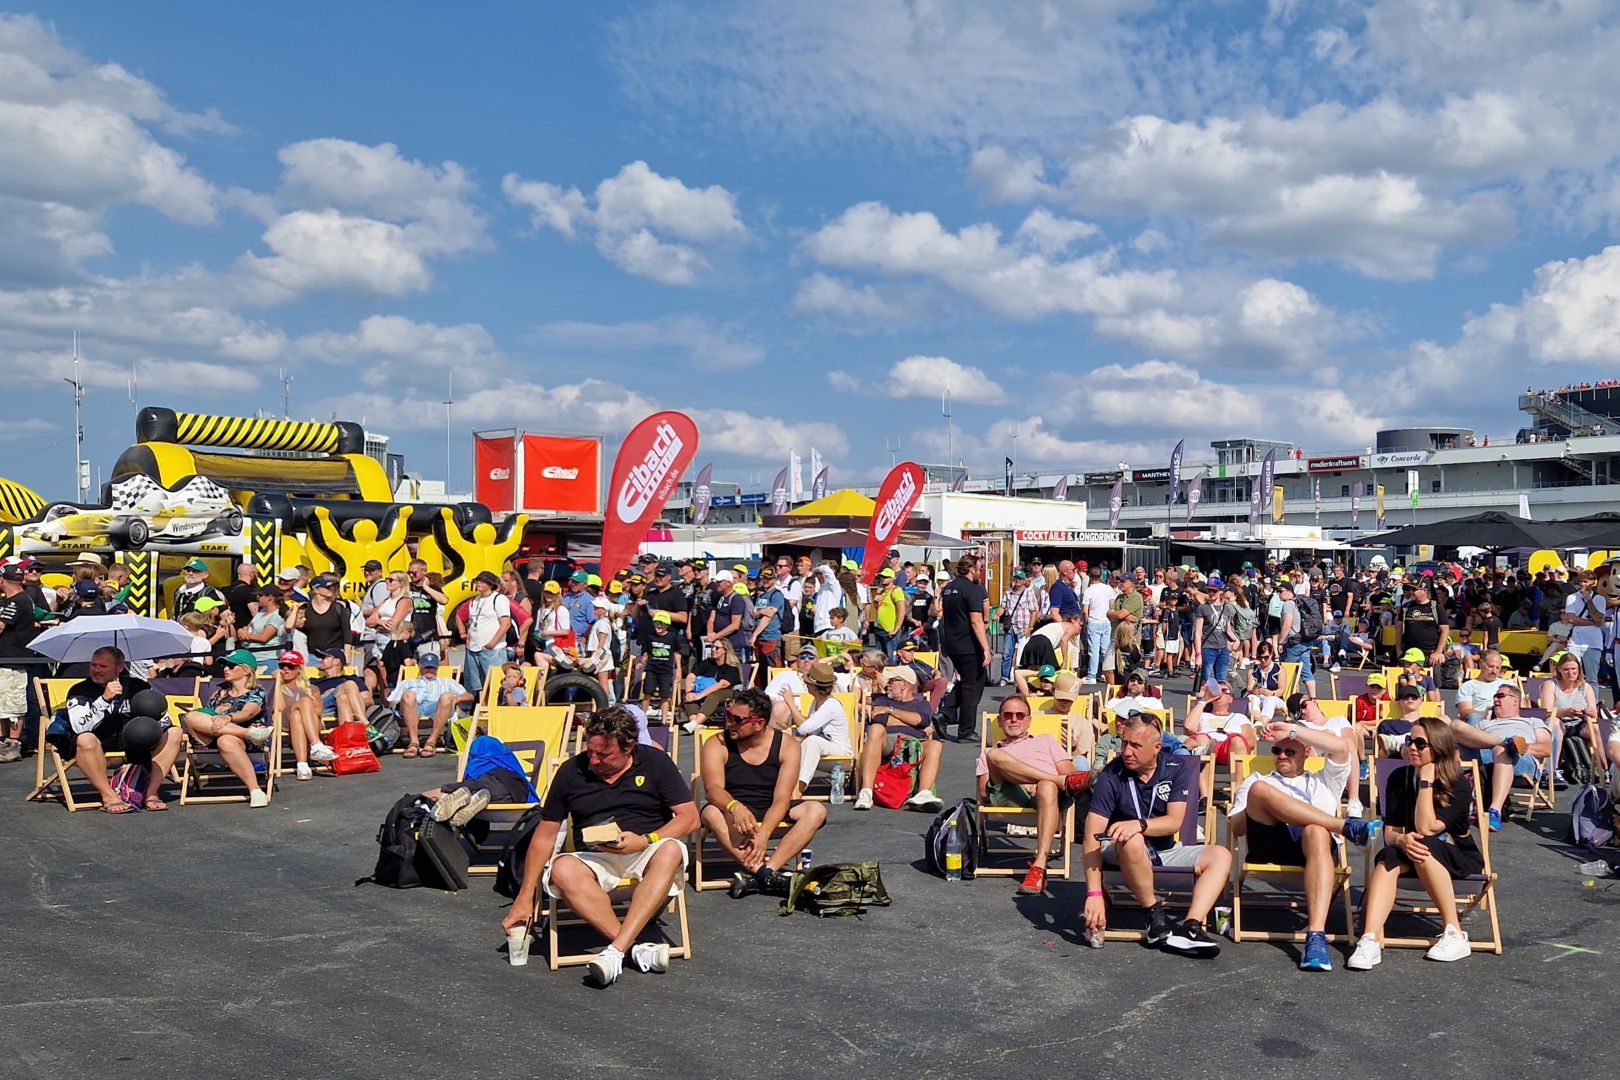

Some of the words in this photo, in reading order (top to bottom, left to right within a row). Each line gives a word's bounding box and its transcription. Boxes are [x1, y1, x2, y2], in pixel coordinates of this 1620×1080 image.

[1310, 459, 1357, 469] medienkraftwerk
[1390, 454, 1421, 464] Concorde
[617, 424, 684, 524] Eibach
[658, 469, 680, 500] eibach.de
[874, 471, 916, 541] Eibach
[171, 520, 207, 533] Windspeed
[1022, 531, 1066, 541] COCKTAILS
[1067, 532, 1073, 540] &
[1074, 531, 1120, 542] LONGDRINKS
[343, 581, 368, 593] FIN
